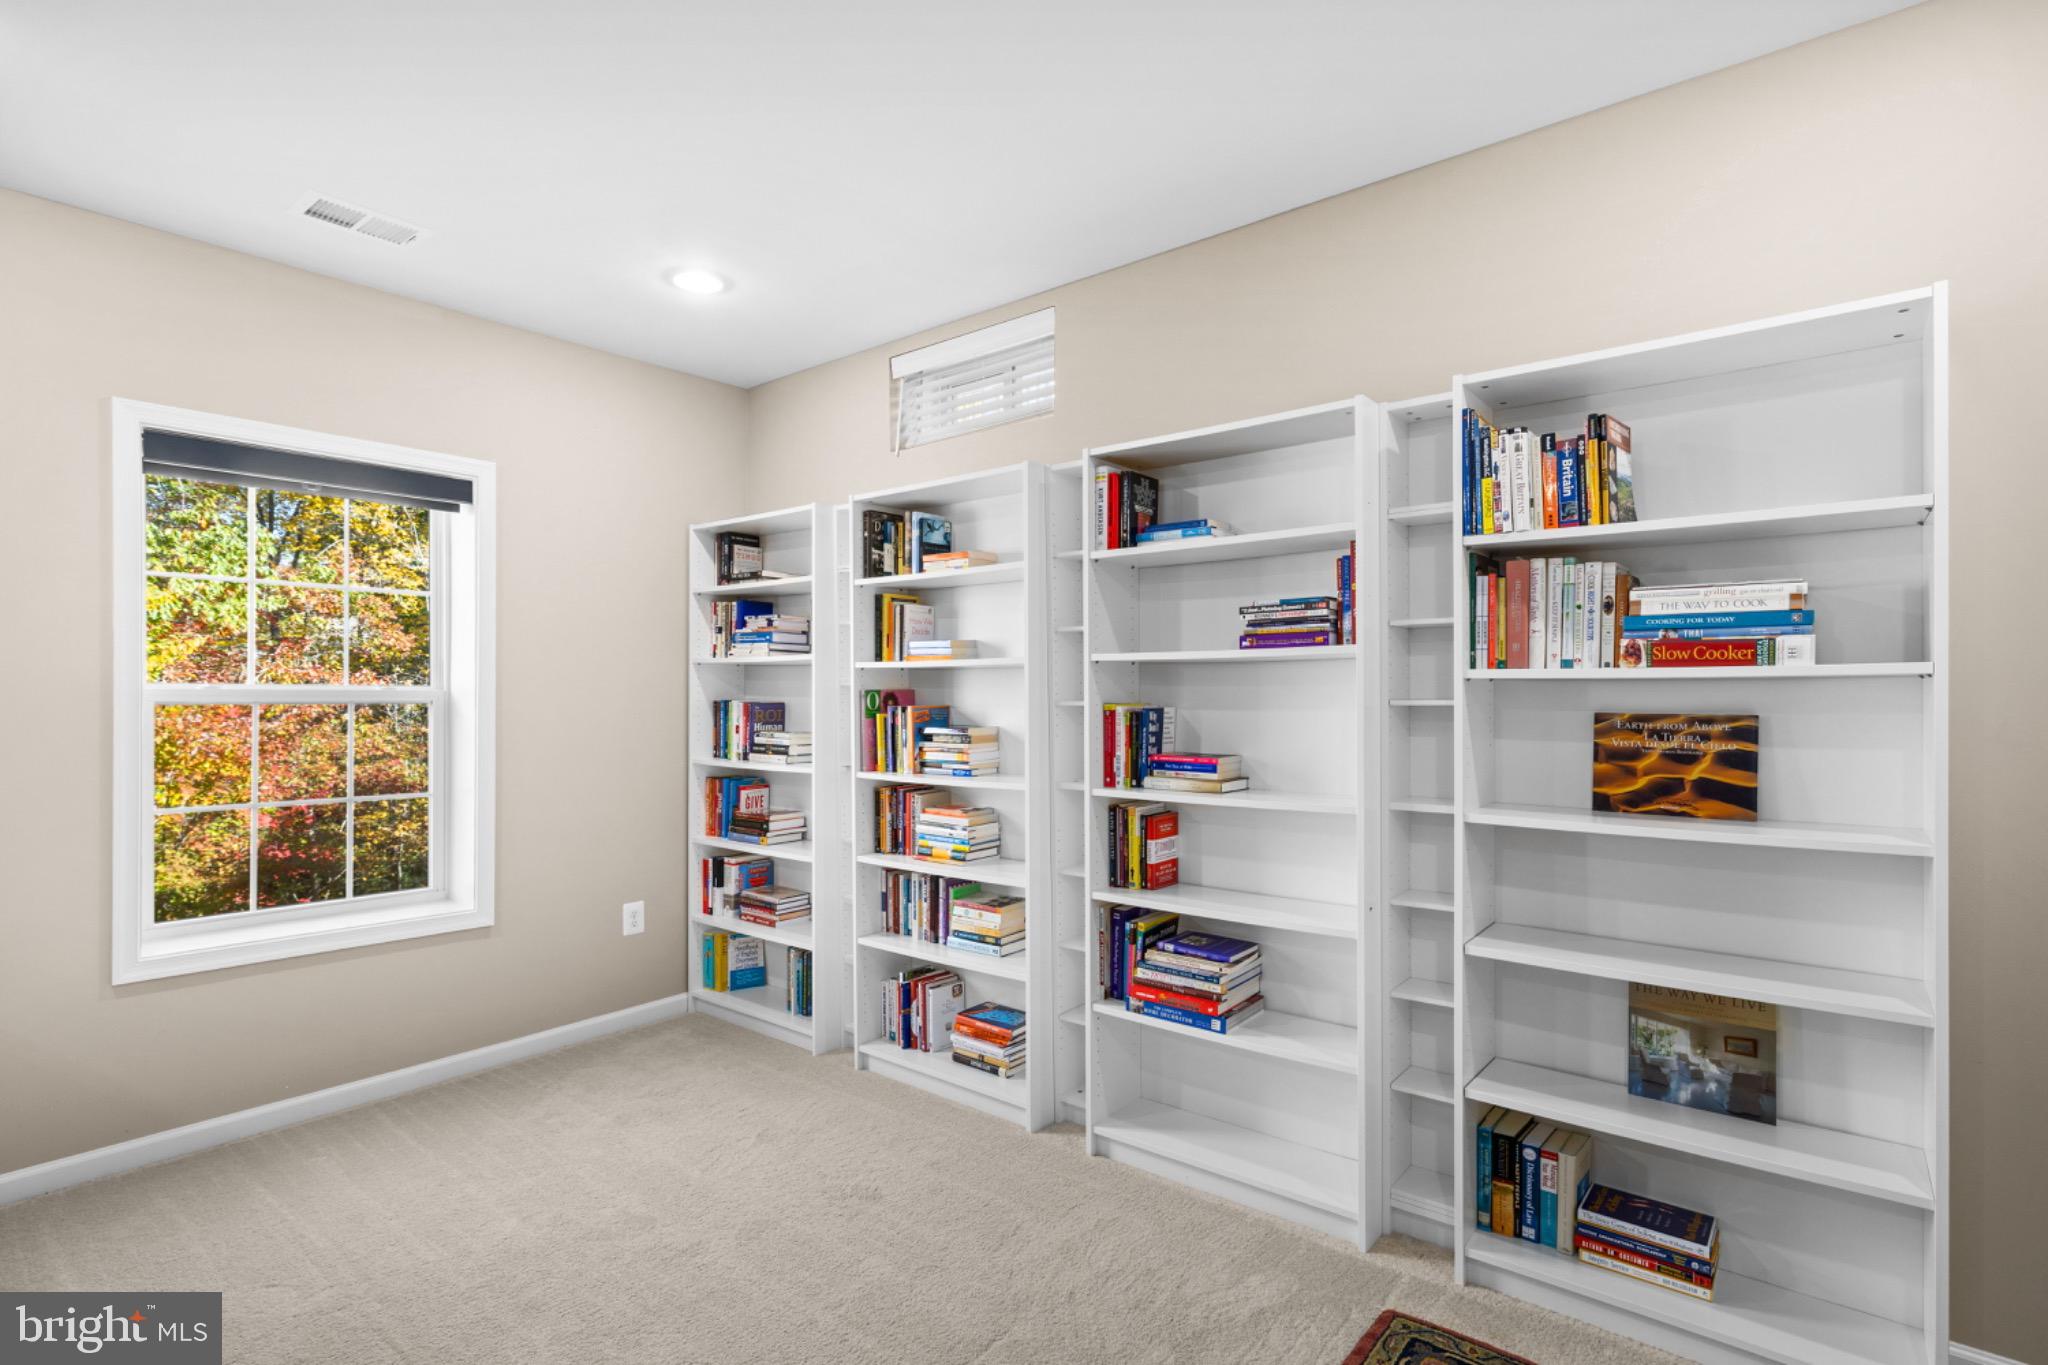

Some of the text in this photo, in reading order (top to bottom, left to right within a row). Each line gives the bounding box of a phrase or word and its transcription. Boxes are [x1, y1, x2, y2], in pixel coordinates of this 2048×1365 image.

[1562, 458, 1574, 498] Britain
[1660, 598, 1768, 611] THE WAY TO COOK
[1646, 617, 1684, 625] COOKING
[1707, 616, 1736, 624] TODAY
[1652, 645, 1692, 661] Slow
[1693, 645, 1755, 661] Cooker
[866, 691, 880, 711] O
[754, 708, 784, 722] ROI
[753, 722, 783, 731] Human
[1617, 720, 1732, 732] EARTH FROM ABOVE
[1611, 738, 1642, 748] VISTA
[1700, 741, 1737, 751] CIELO
[1644, 732, 1702, 743] LA TIERRA
[745, 794, 765, 810] GIVE
[1667, 987, 1698, 1001] WAY
[1702, 992, 1727, 1006] WE
[1731, 997, 1767, 1012] LIVE
[1524, 1161, 1535, 1225] Dictionary of Law
